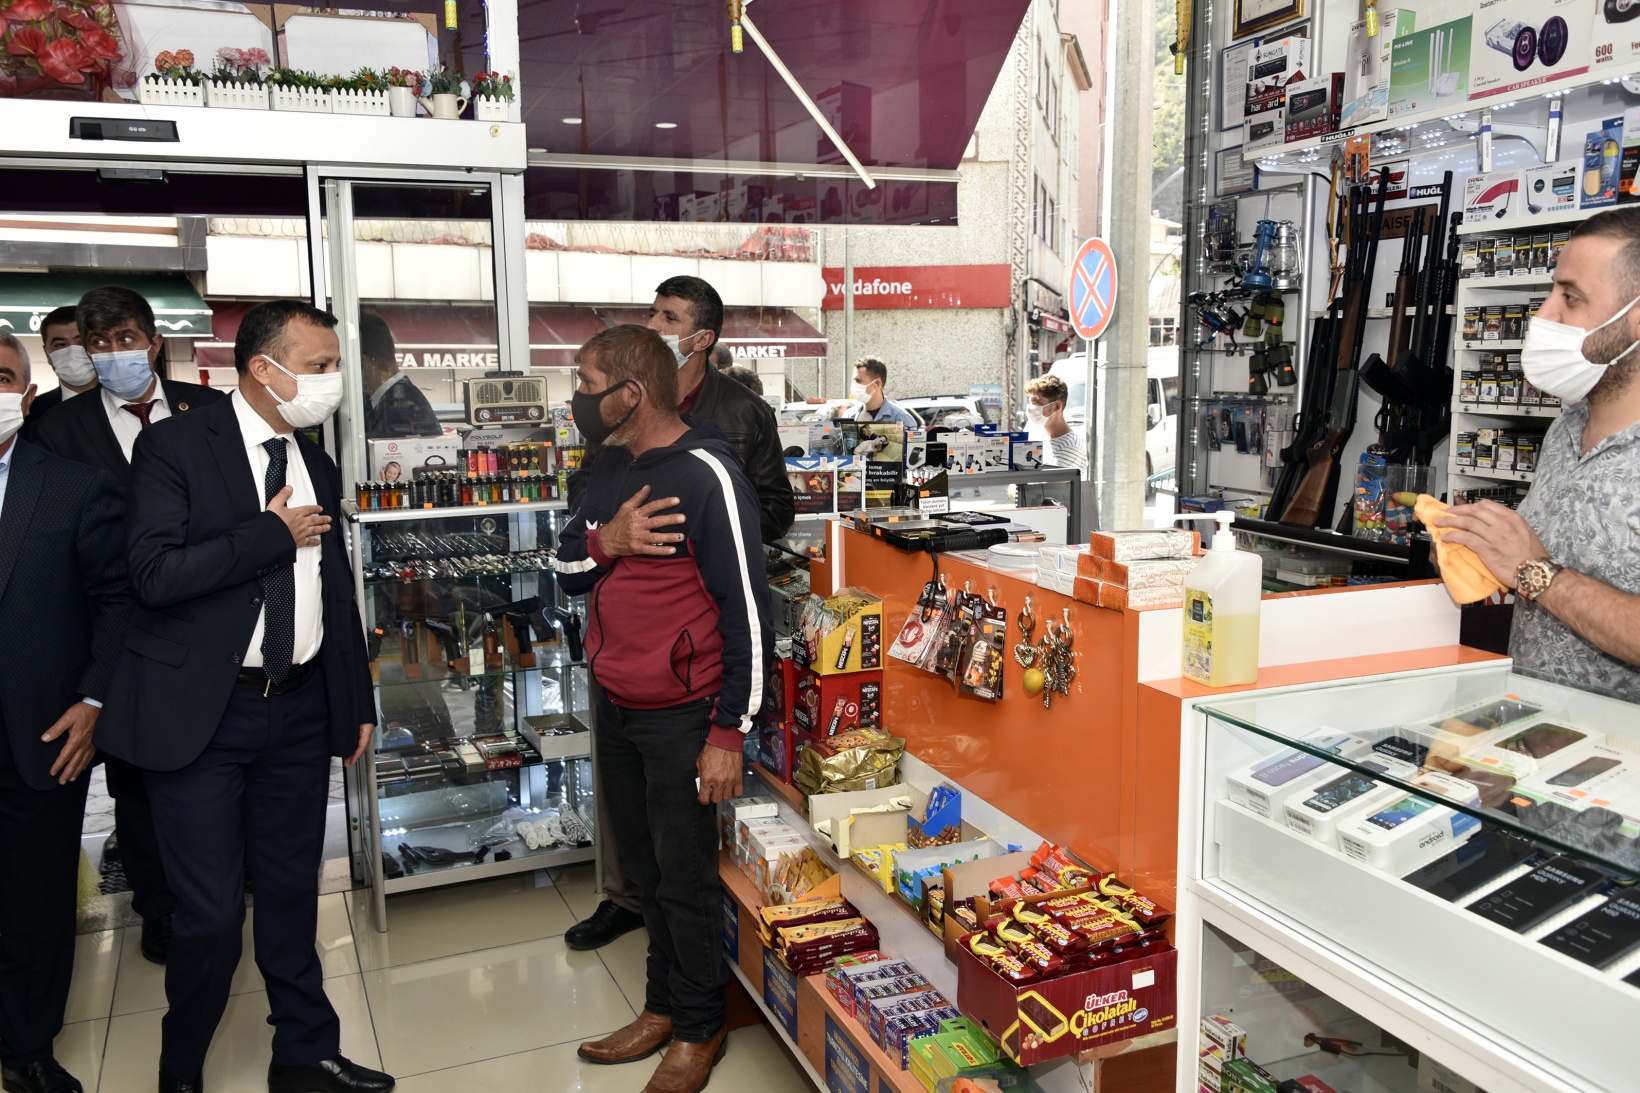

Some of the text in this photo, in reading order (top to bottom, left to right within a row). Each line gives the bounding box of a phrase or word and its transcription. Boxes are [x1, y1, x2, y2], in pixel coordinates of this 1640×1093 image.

[1595, 43, 1613, 57] 600
[1596, 55, 1613, 64] watts
[1508, 77, 1547, 93] CAR SPEAKER
[1326, 129, 1355, 141] HUĞLU
[1416, 186, 1443, 196] HUĞL
[1418, 831, 1444, 848] android
[1544, 866, 1585, 885] SAMSUNG
[1085, 990, 1128, 1011] ÜLKER
[1069, 997, 1137, 1039] Çikolatalı
[1082, 1012, 1133, 1037] GOFRET
